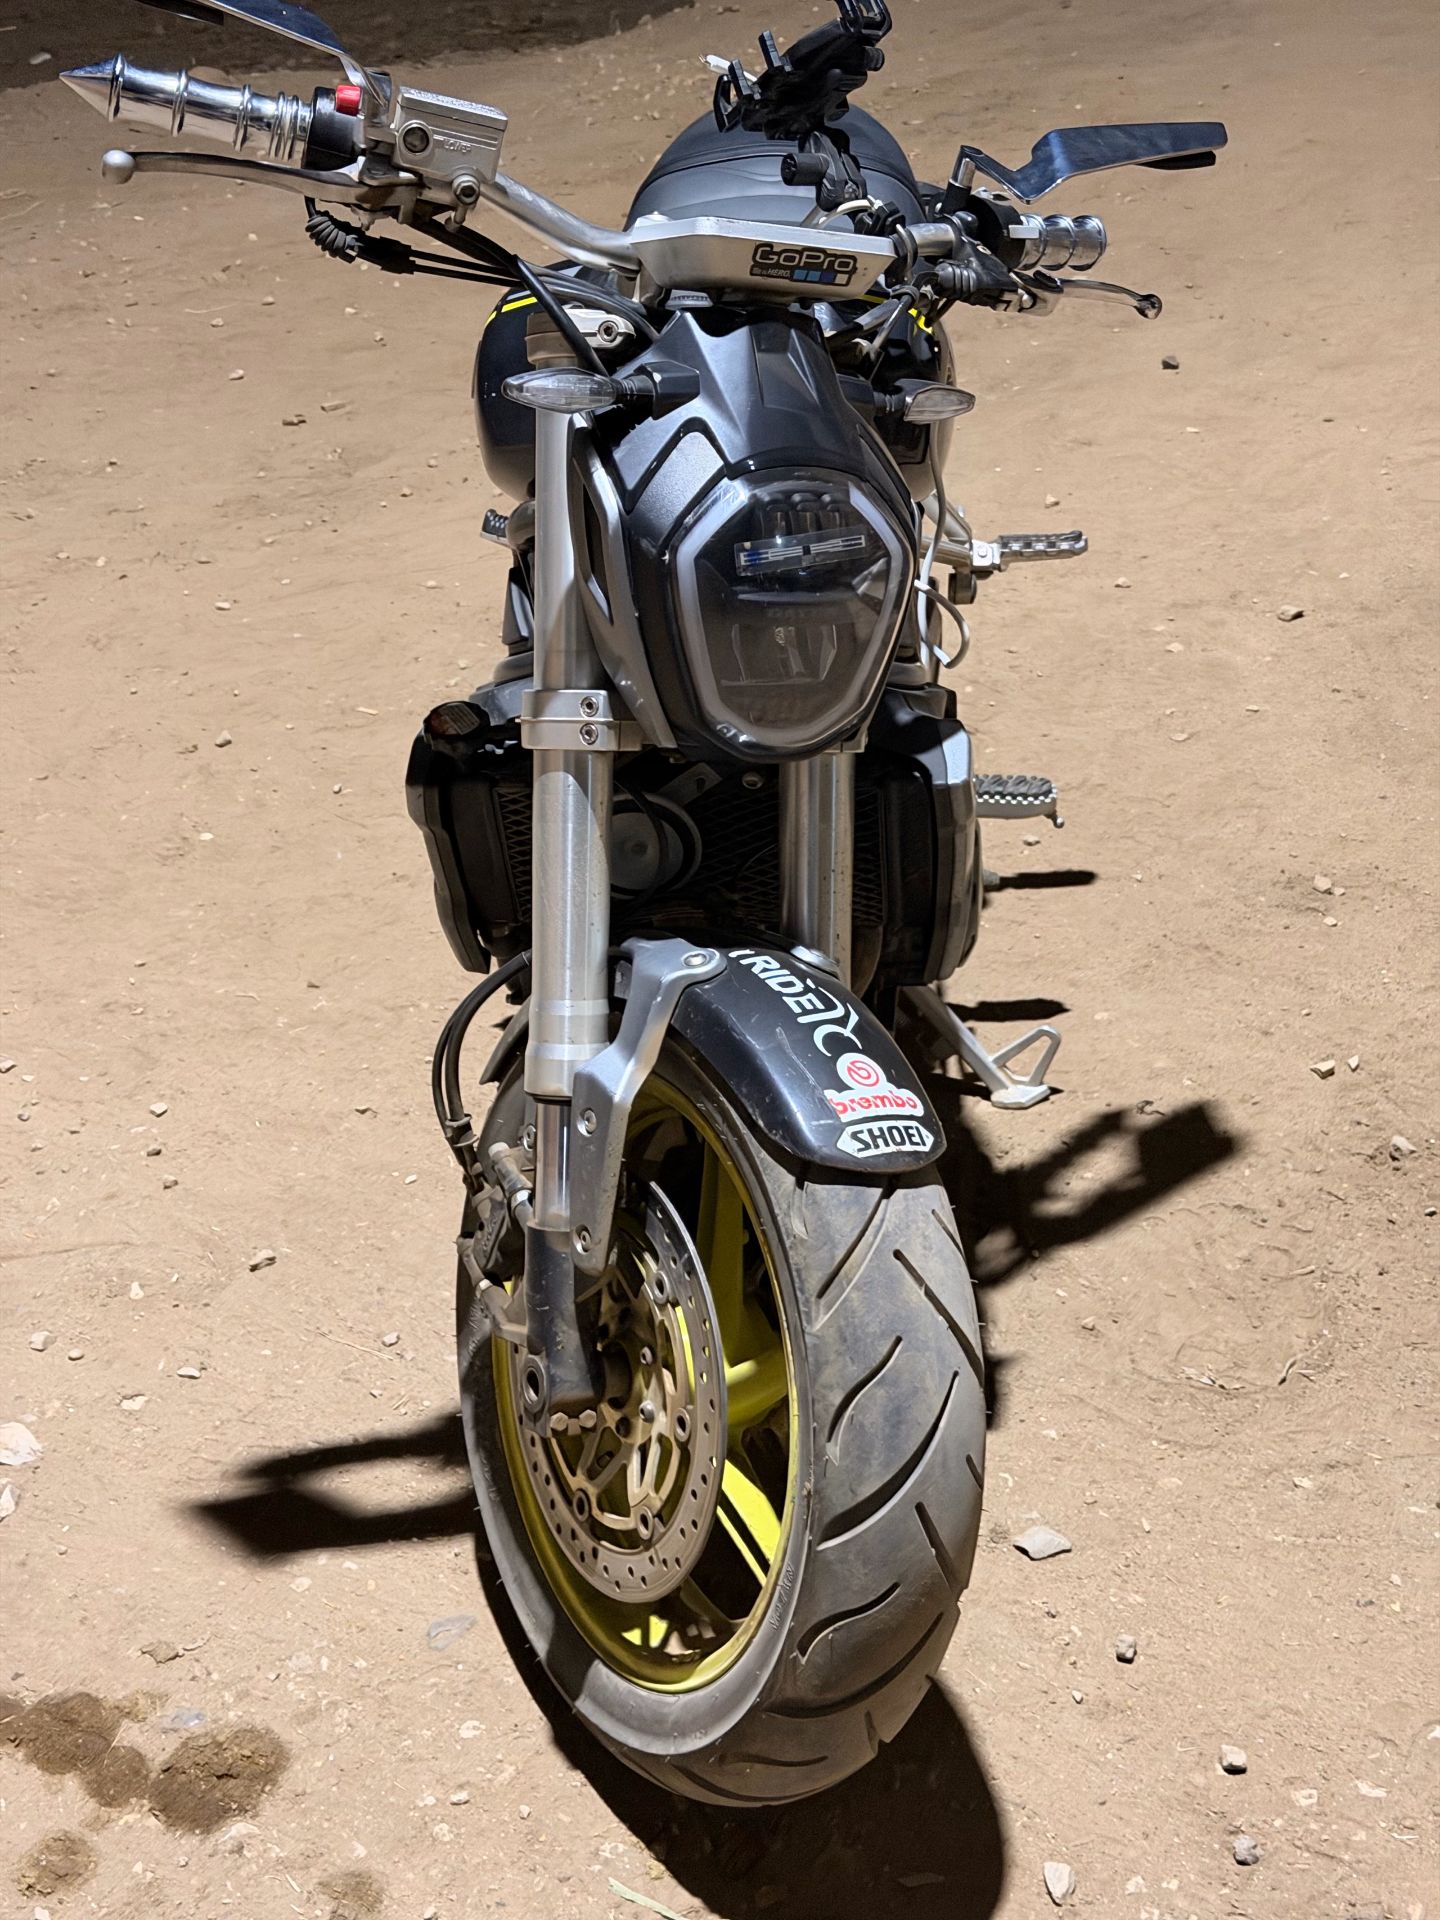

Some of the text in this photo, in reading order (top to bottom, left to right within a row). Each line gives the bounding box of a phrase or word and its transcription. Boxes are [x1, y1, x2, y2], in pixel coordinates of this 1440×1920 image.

[755, 246, 854, 272] GoPro
[828, 1089, 918, 1116] brembo
[850, 1125, 927, 1154] SHOEI
